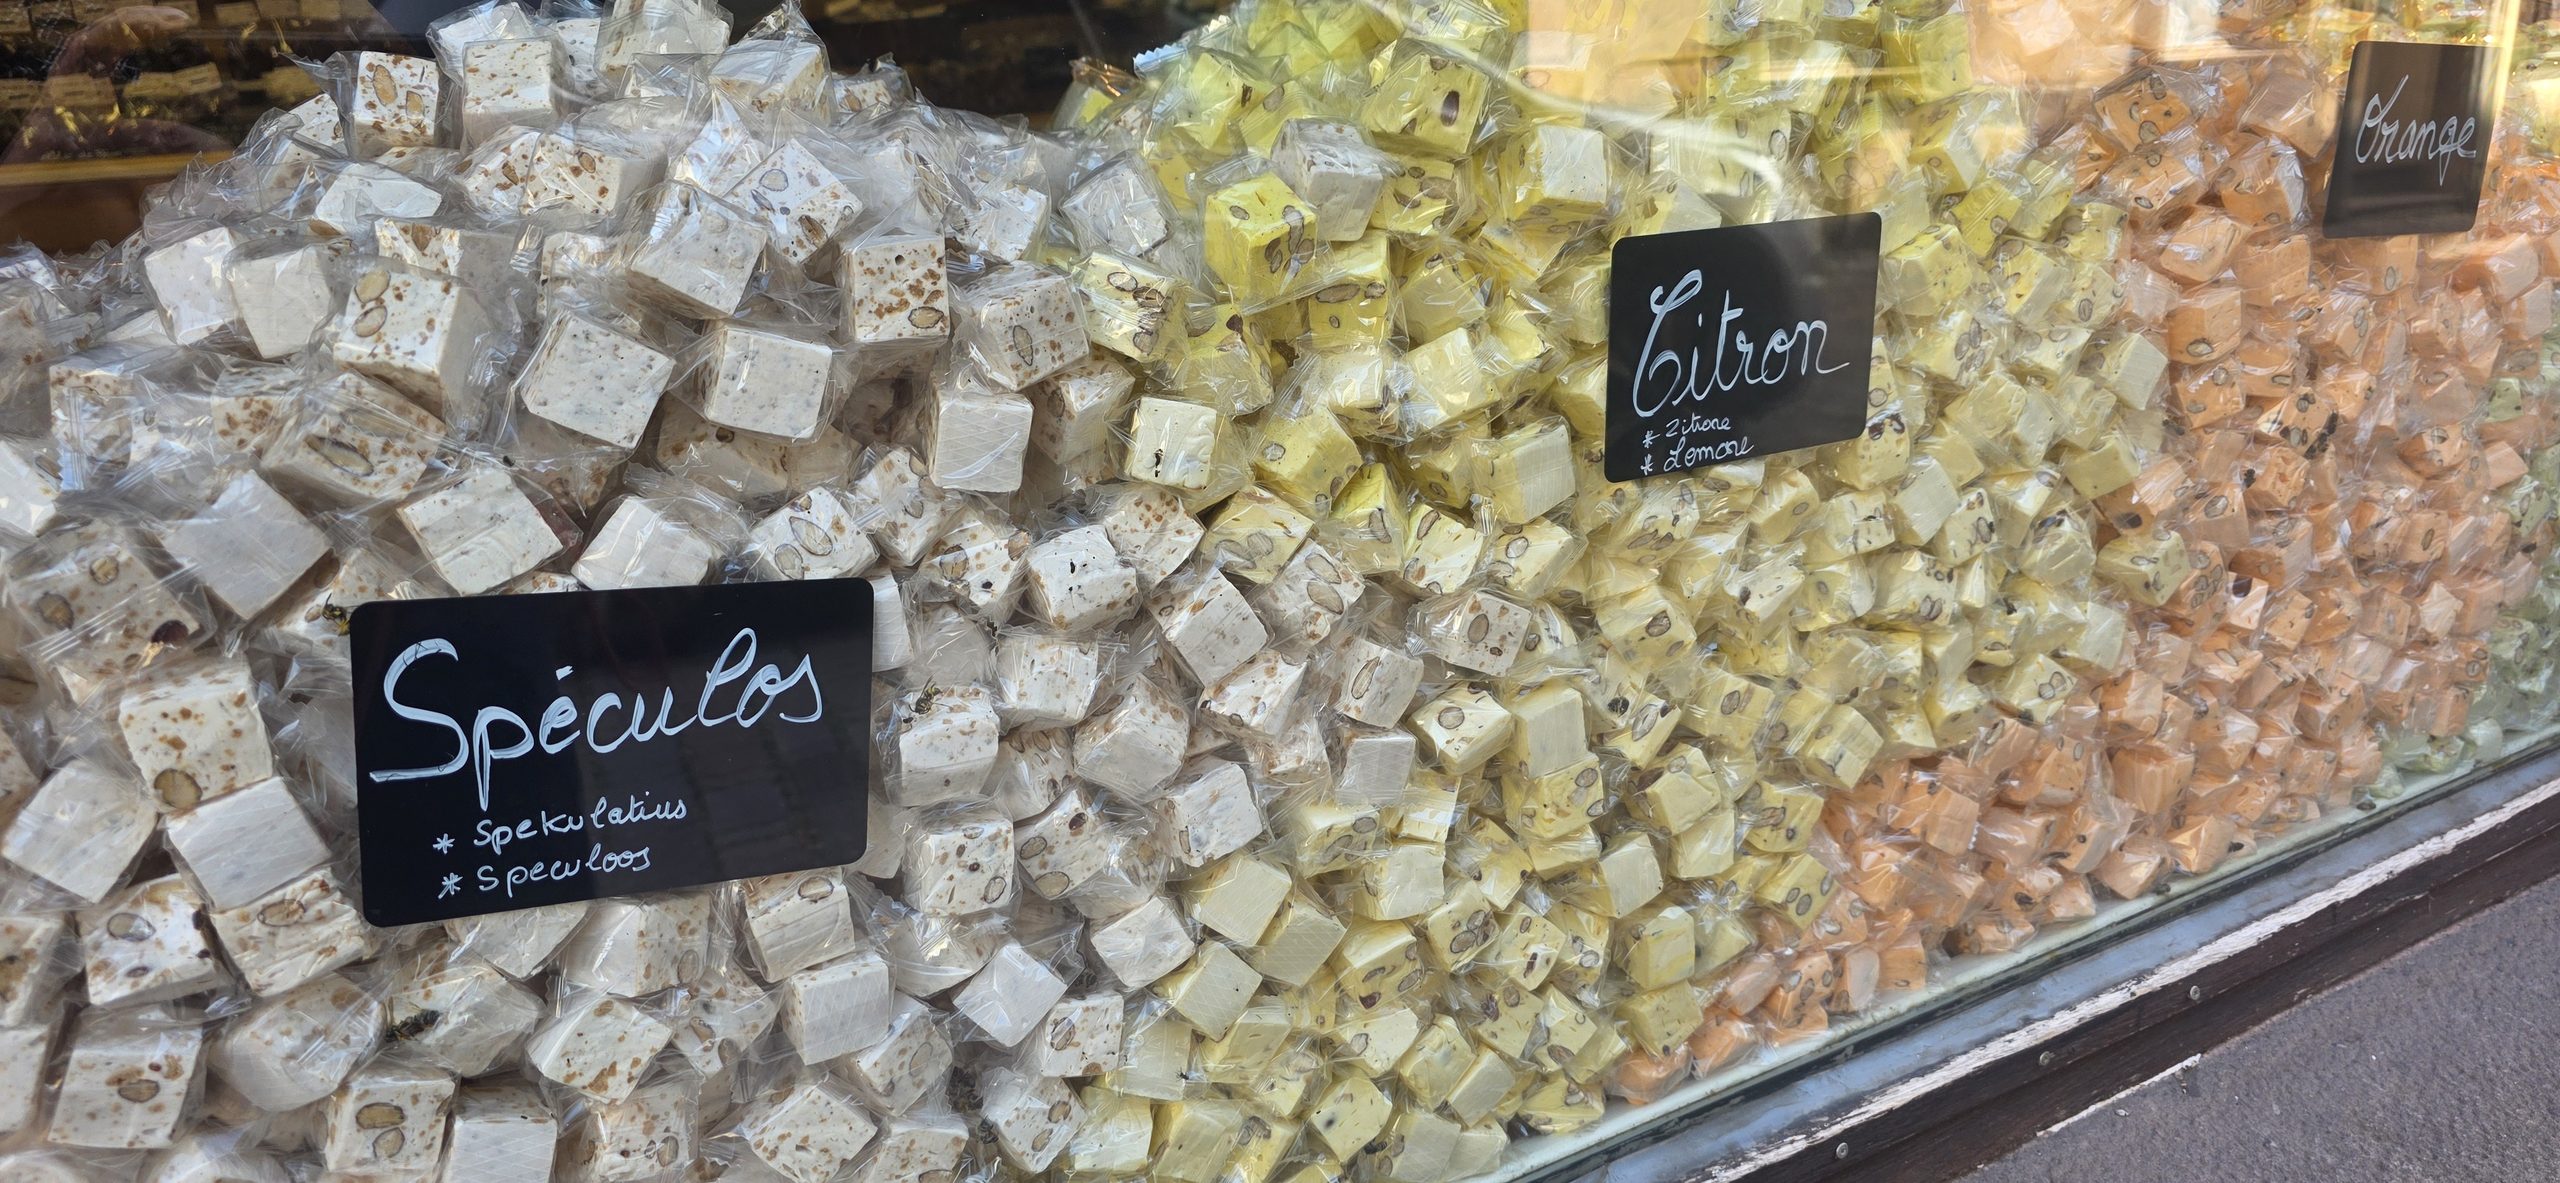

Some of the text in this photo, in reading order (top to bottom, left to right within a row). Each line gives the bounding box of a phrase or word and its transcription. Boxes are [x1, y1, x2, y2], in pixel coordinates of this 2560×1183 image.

[2356, 74, 2477, 186] Orange
[1633, 268, 1850, 417] Citron
[1665, 412, 1731, 437] Zitrone
[369, 627, 823, 811] Spéculos
[473, 791, 687, 855] Spekulatius
[478, 845, 650, 897] Speculoos
